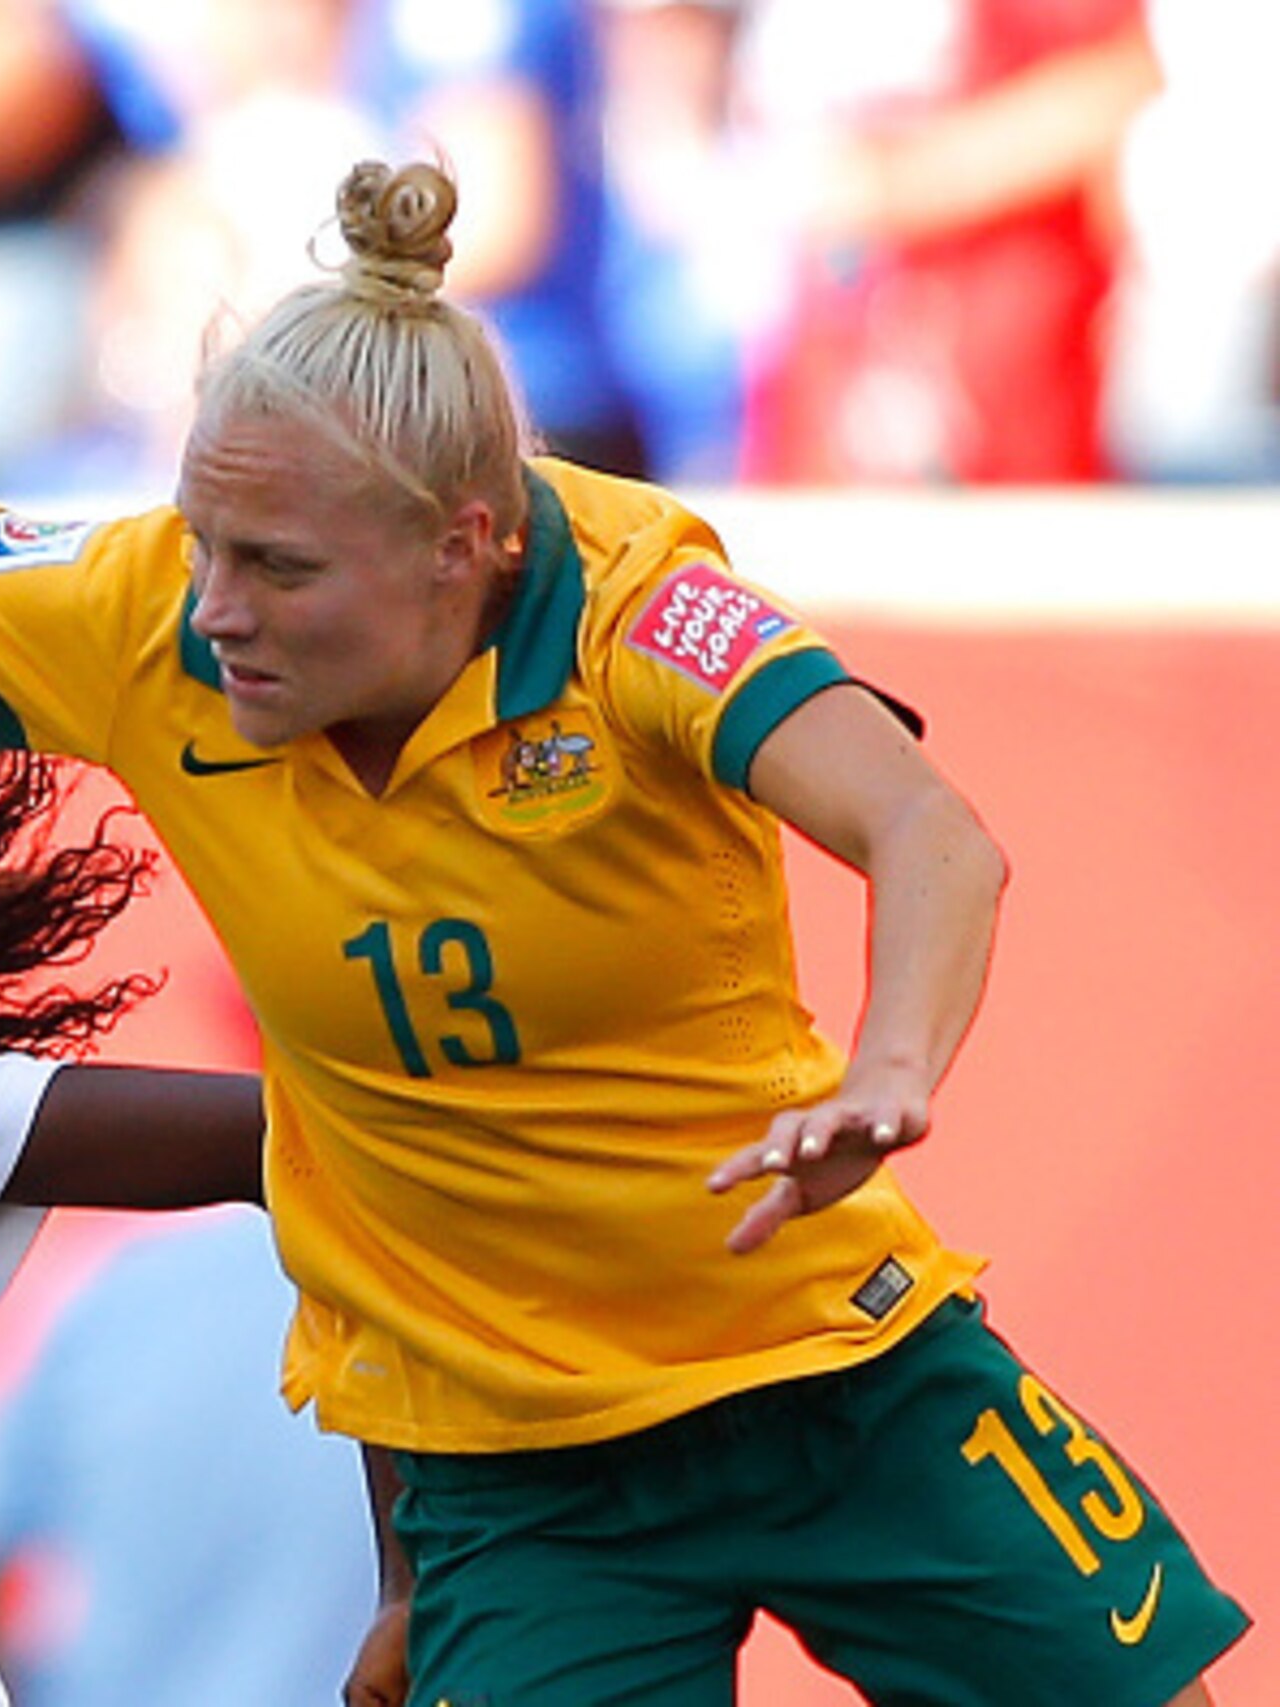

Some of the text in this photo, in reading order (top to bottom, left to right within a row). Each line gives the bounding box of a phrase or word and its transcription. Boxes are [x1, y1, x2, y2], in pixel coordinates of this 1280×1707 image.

[653, 581, 700, 648] LIVE
[674, 585, 735, 657] YOUR
[698, 592, 761, 675] GOALS
[342, 917, 522, 1078] 13
[960, 1373, 1145, 1577] 13
